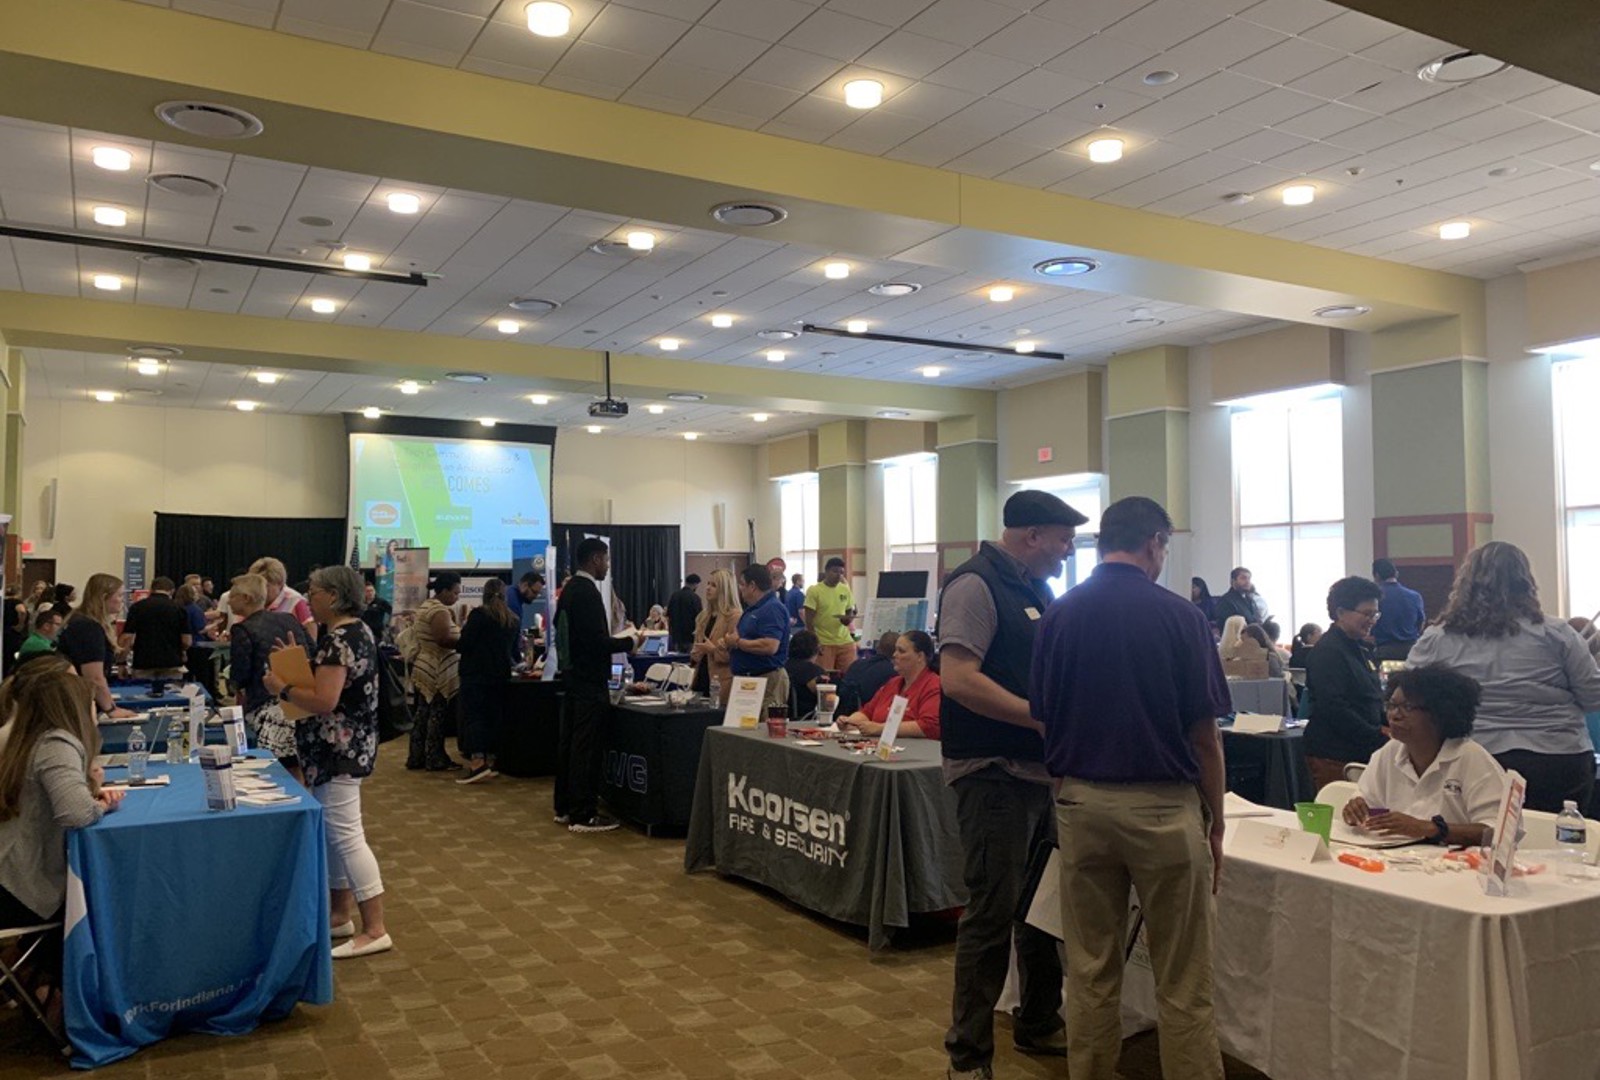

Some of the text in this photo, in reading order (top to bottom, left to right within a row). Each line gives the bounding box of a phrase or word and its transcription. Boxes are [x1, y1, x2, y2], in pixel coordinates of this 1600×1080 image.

[728, 772, 846, 846] Koorsen
[762, 822, 771, 840] &
[774, 828, 849, 868] SECURITY
